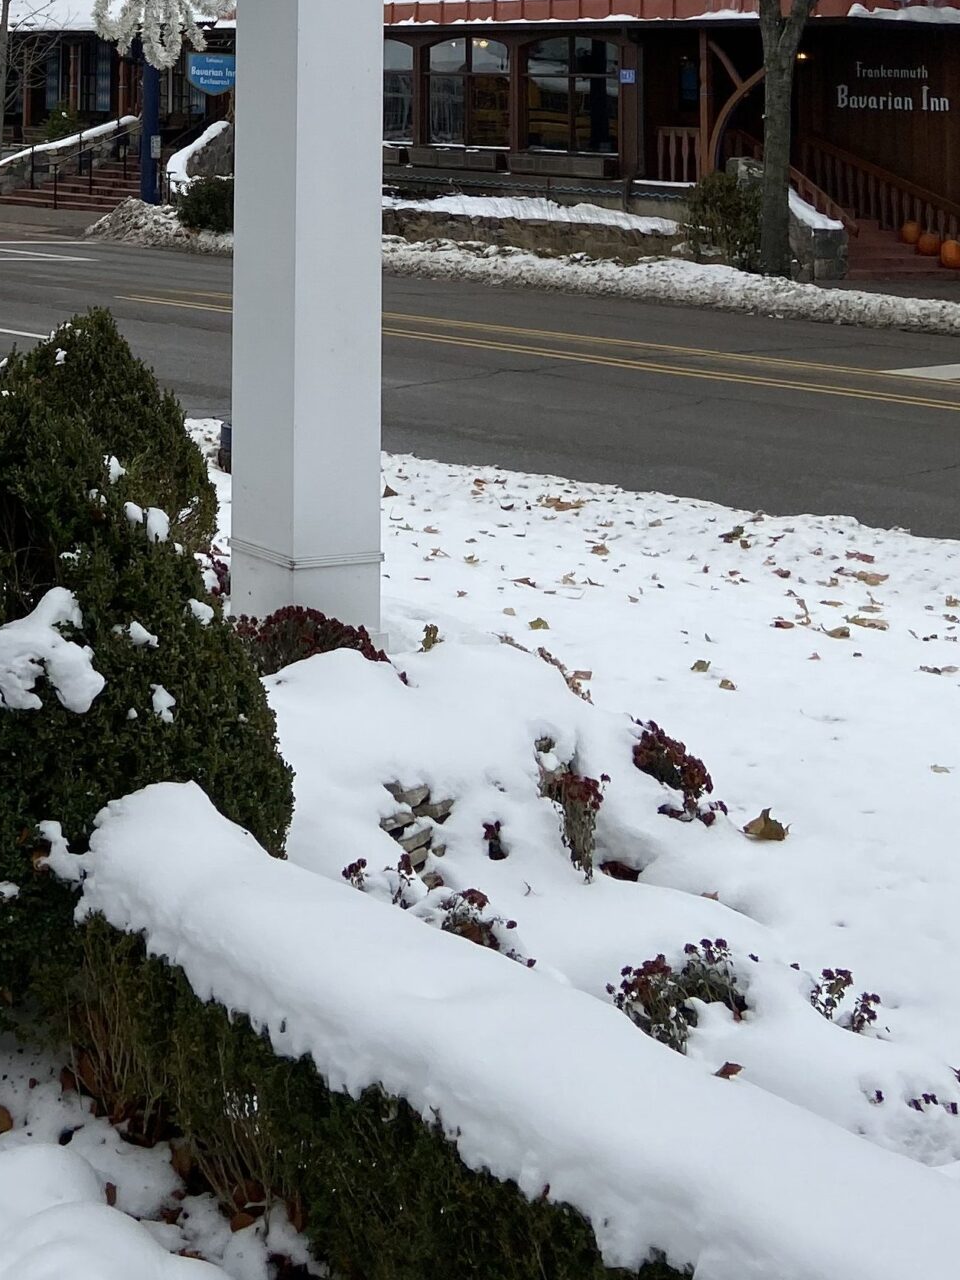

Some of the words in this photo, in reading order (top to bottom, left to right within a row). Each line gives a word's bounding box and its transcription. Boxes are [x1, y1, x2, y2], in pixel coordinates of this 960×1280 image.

[191, 66, 223, 77] Bavarian
[856, 61, 929, 79] Frankenmuth
[836, 84, 913, 111] Bavarian
[921, 85, 950, 112] Inn
